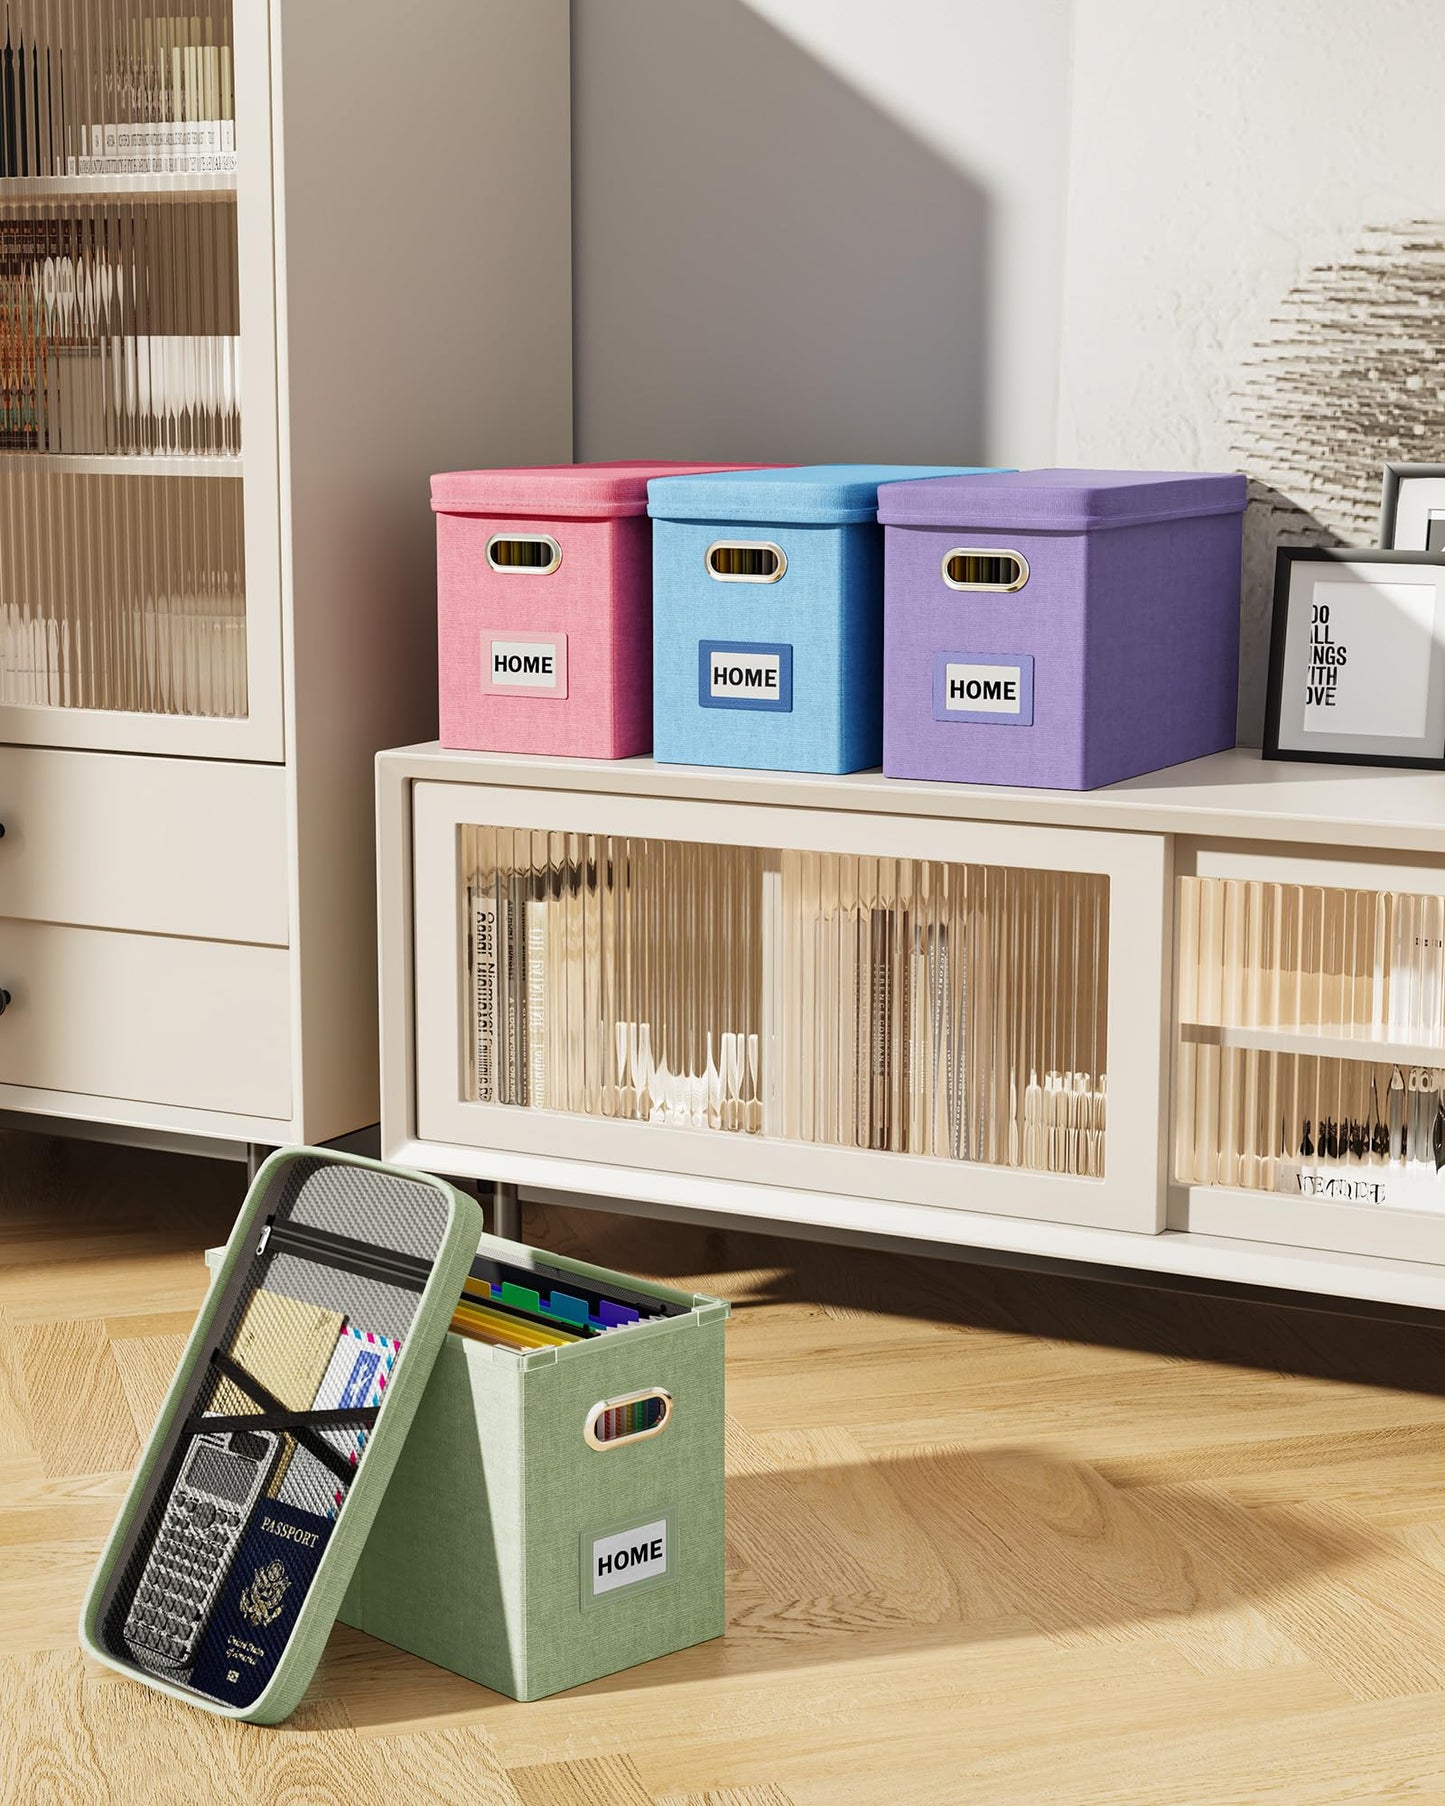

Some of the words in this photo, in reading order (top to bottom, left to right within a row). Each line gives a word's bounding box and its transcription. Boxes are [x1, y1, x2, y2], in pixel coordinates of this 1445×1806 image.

[1310, 624, 1335, 645] LL
[494, 654, 553, 675] HOME
[1308, 665, 1338, 686] ITH
[713, 666, 777, 688] HOME
[950, 679, 1016, 701] HOME
[260, 1516, 319, 1548] PASSPORT
[597, 1537, 664, 1577] HOME
